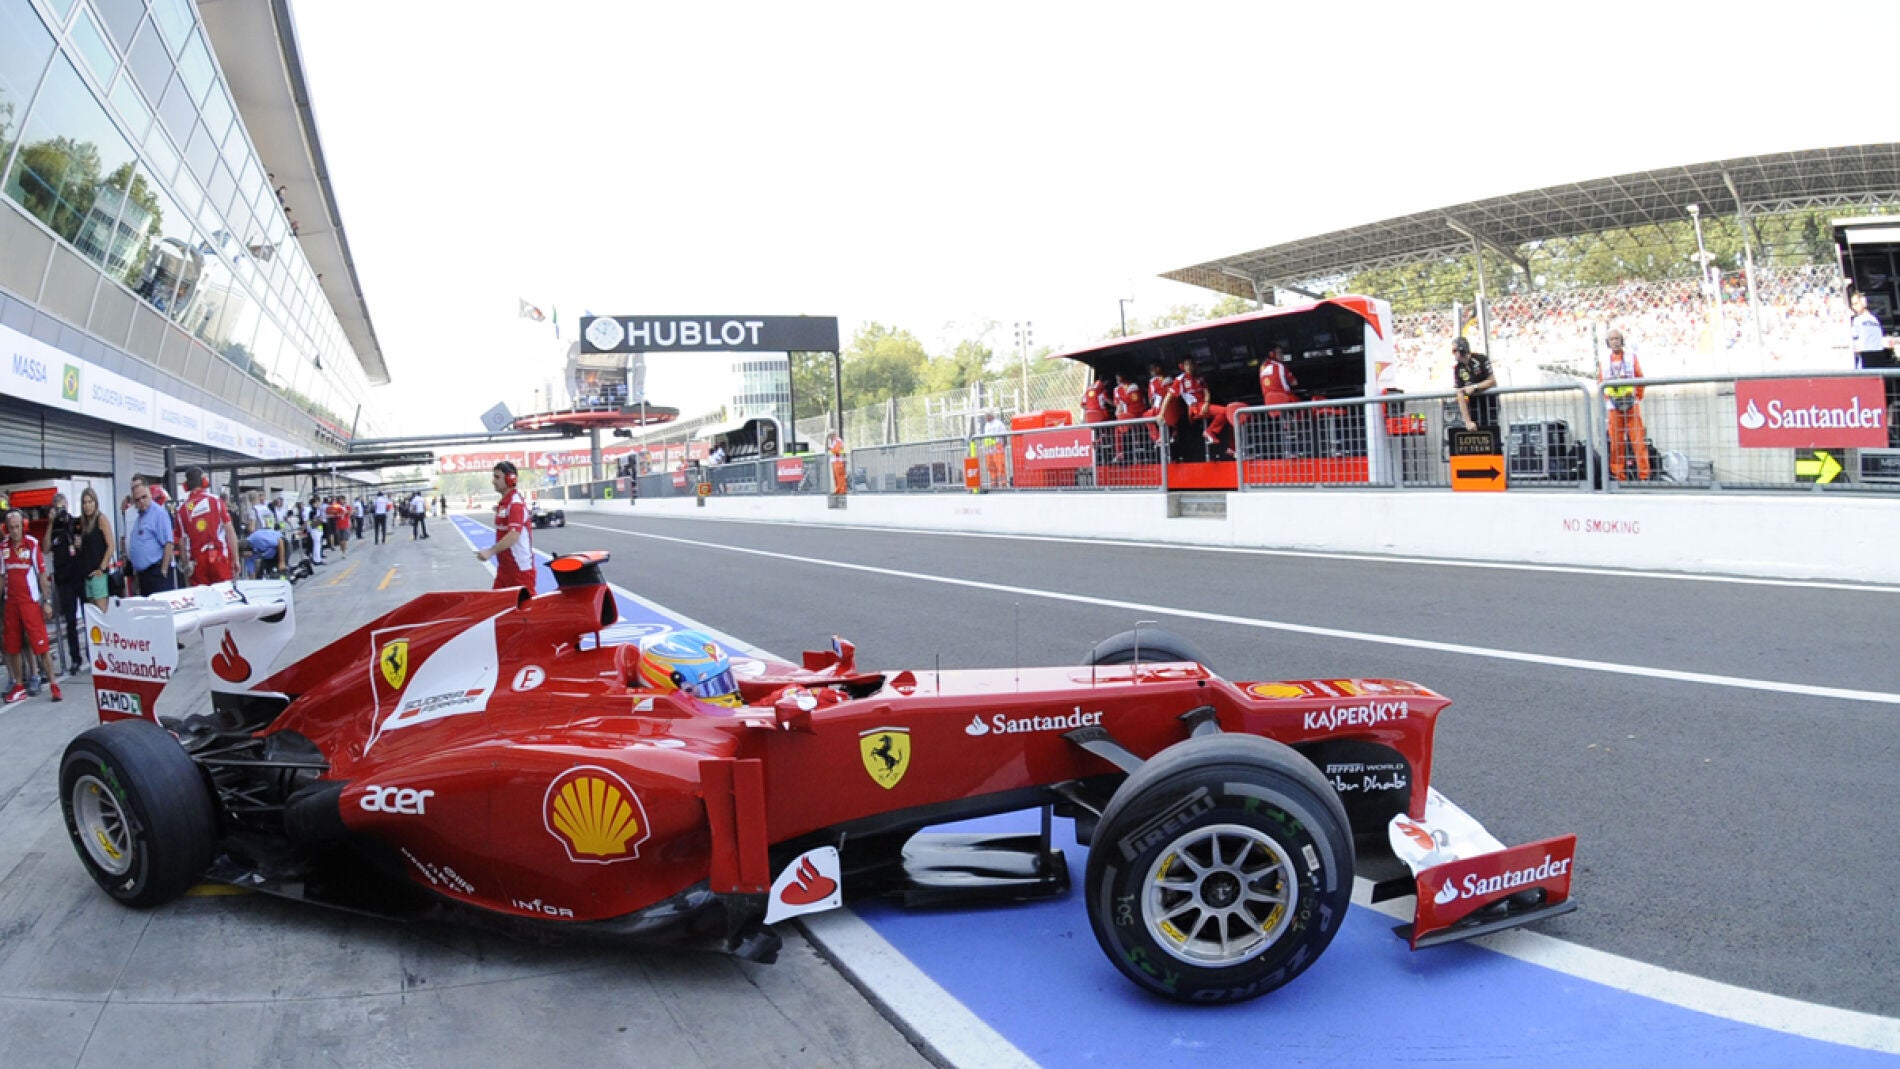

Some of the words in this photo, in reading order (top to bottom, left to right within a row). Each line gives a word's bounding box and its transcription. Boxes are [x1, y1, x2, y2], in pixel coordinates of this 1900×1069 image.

[627, 320, 764, 346] HUBLOT
[13, 352, 48, 384] MASSA
[1767, 396, 1882, 430] Santander
[1036, 439, 1090, 460] Santander
[1459, 436, 1489, 446] LOTUS
[1563, 518, 1581, 533] NO
[1585, 518, 1641, 535] SMOKING
[104, 631, 151, 652] V-Power
[107, 653, 172, 680] Santander
[100, 691, 130, 711] AMD
[991, 705, 1103, 735] Santander
[1303, 700, 1399, 731] KASPERSKY
[1330, 775, 1359, 792] bu
[1363, 773, 1407, 792] Dhabi
[360, 784, 435, 816] acer
[1118, 786, 1216, 861] PIRELLI
[1459, 854, 1572, 899] Santander
